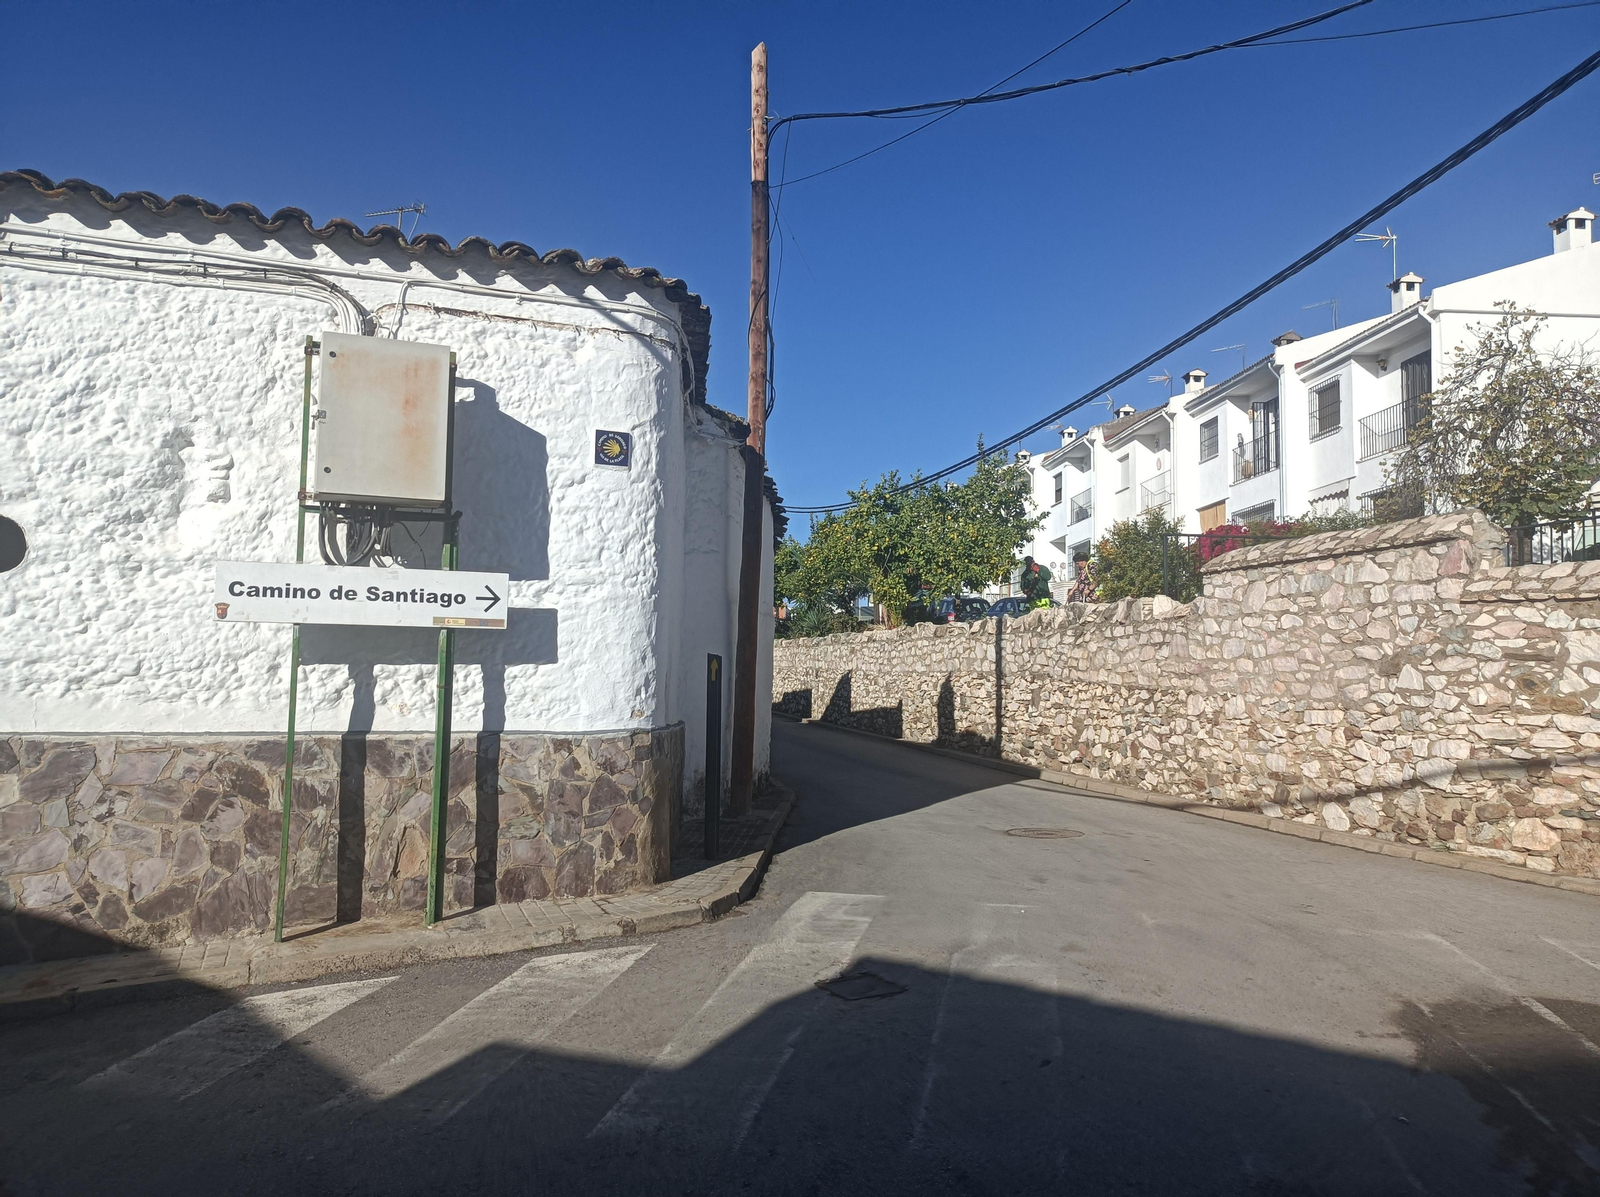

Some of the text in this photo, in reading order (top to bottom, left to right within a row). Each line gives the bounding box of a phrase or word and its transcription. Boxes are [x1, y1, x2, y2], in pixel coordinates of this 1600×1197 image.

[228, 581, 466, 608] Camino de Santiago
